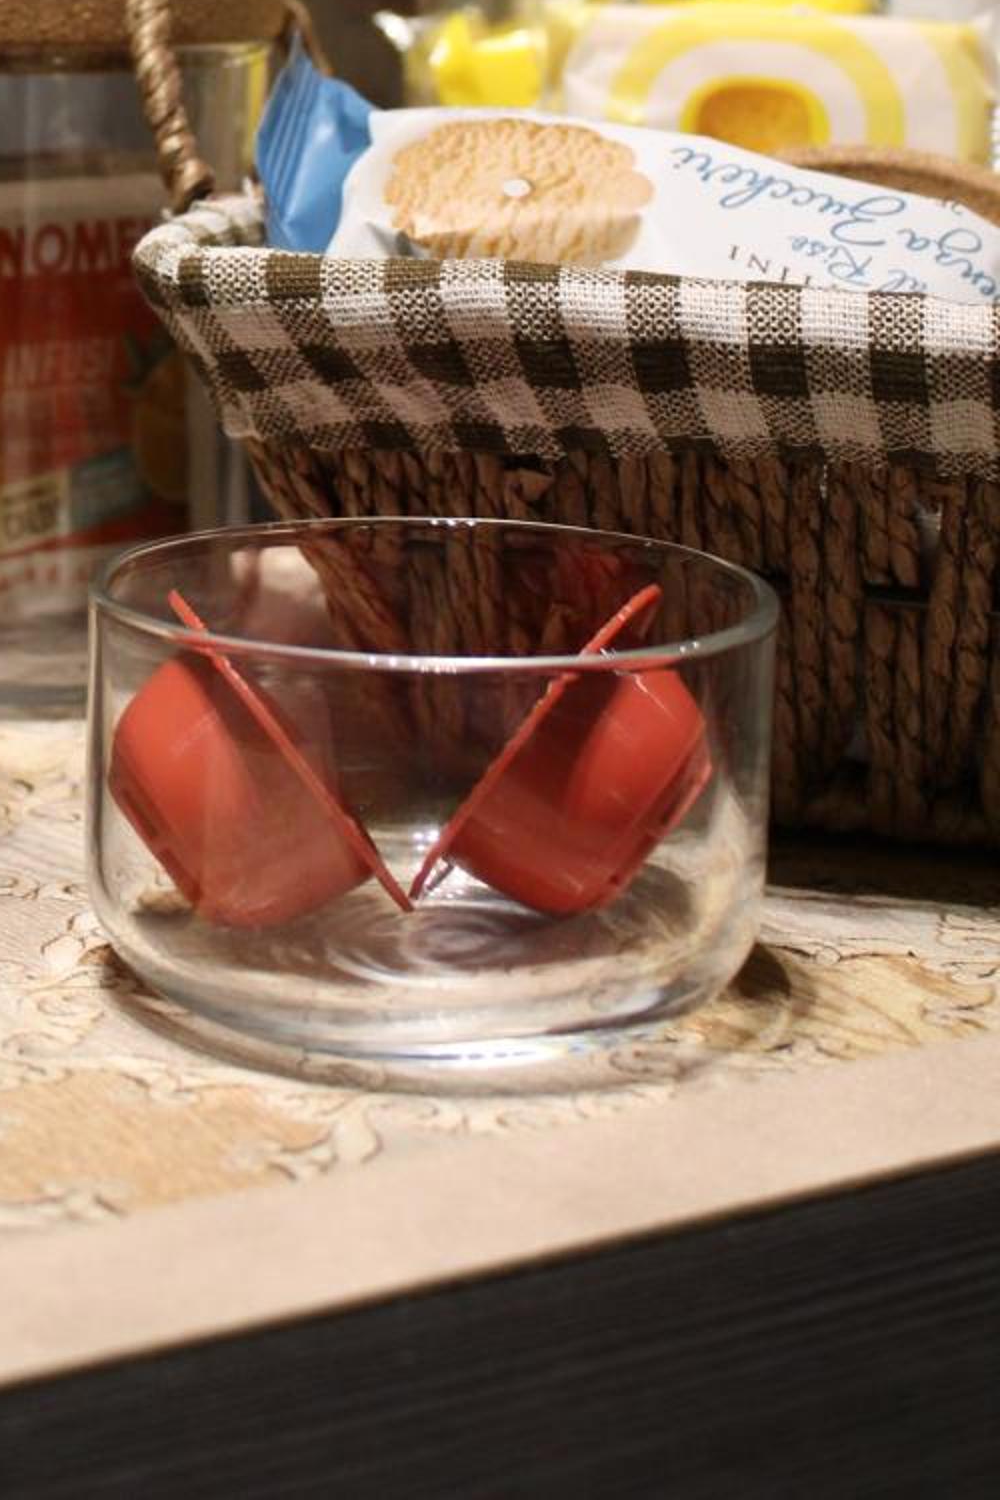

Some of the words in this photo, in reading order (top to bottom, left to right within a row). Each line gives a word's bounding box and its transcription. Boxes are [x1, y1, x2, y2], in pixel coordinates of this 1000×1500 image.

[669, 145, 907, 247] Zuccheri
[790, 235, 873, 288] Riso
[897, 227, 1000, 304] enza
